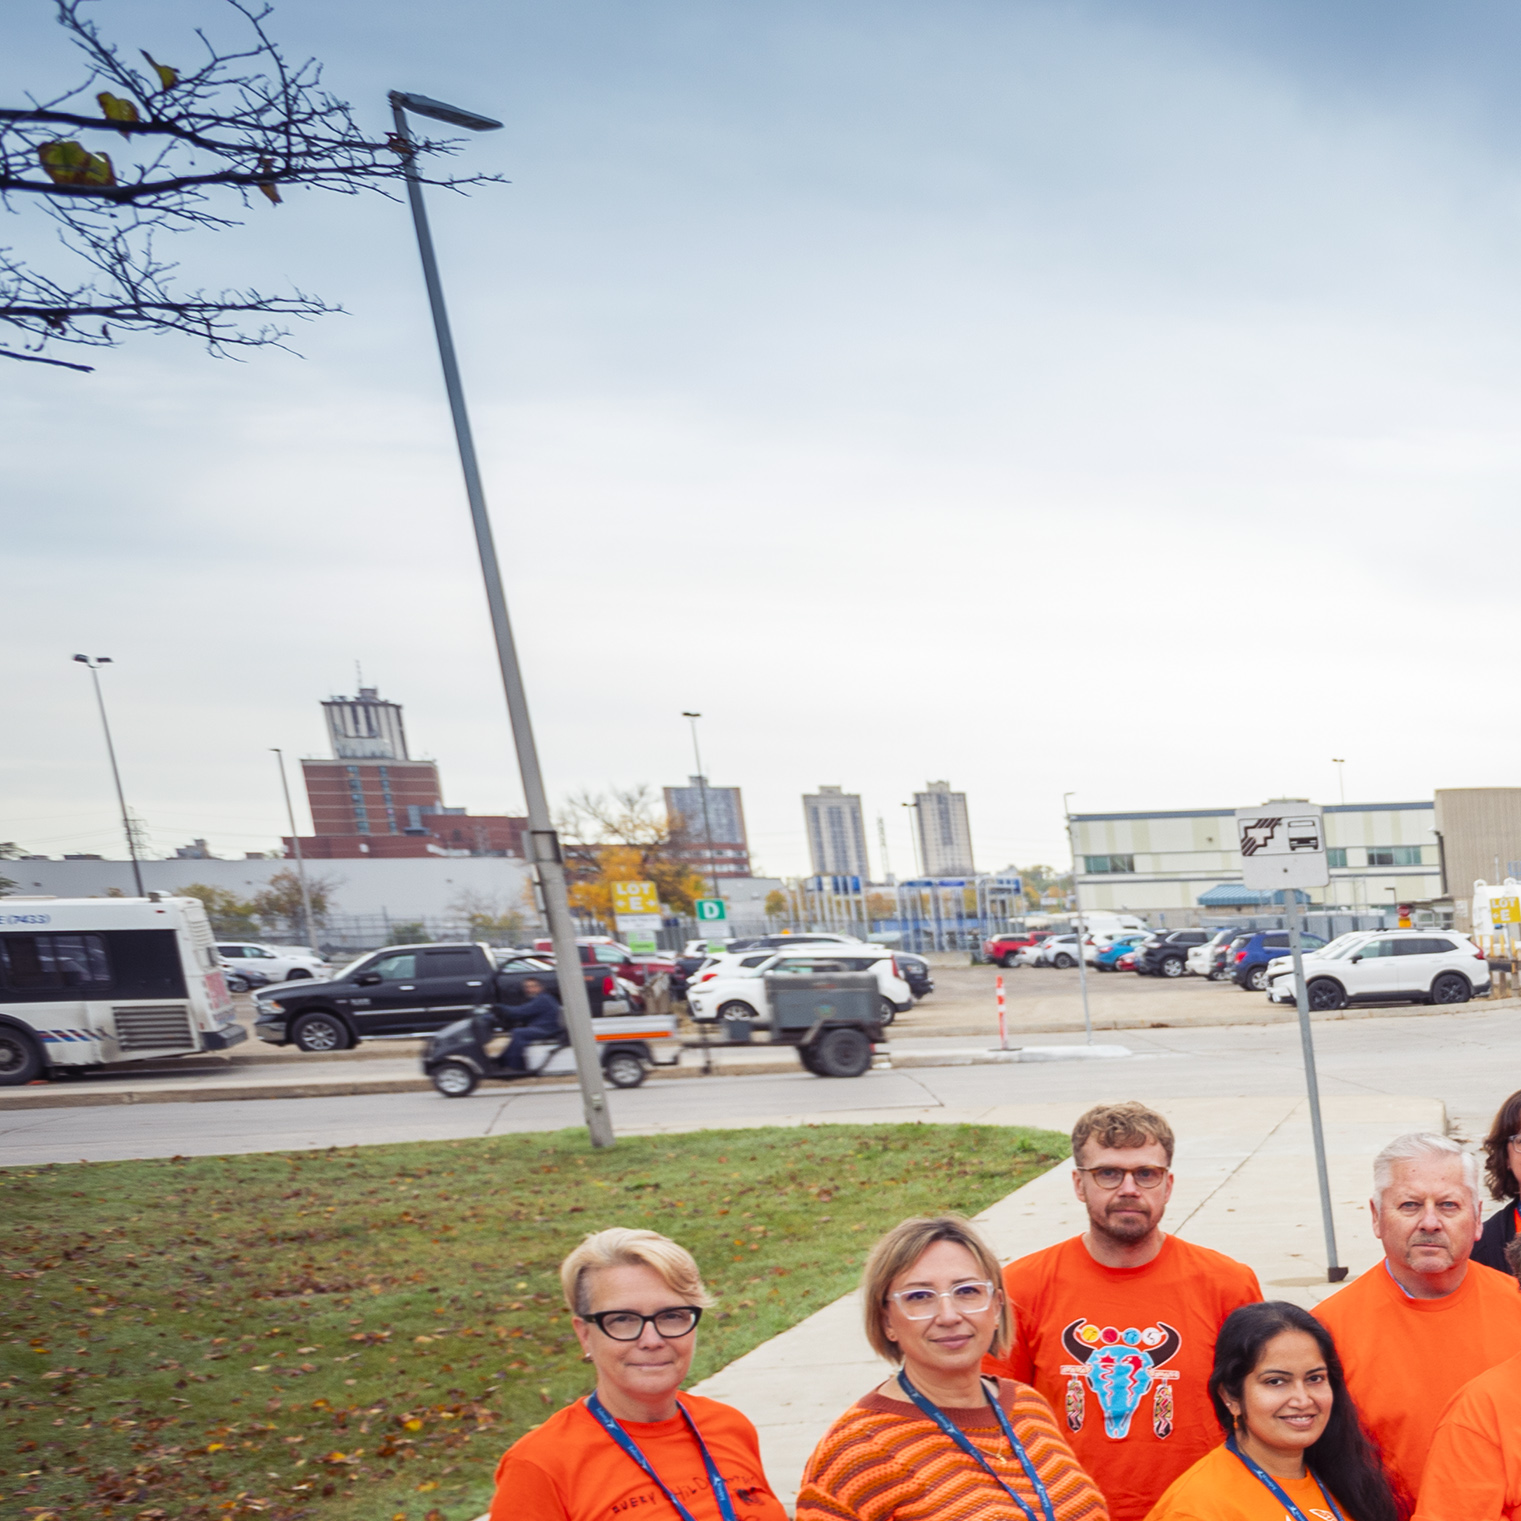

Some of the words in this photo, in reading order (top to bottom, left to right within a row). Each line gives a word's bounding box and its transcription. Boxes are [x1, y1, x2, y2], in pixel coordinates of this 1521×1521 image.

[616, 883, 651, 895] LOT
[628, 897, 644, 911] E
[1492, 898, 1516, 908] LOT
[702, 902, 720, 919] D
[1501, 909, 1511, 921] E
